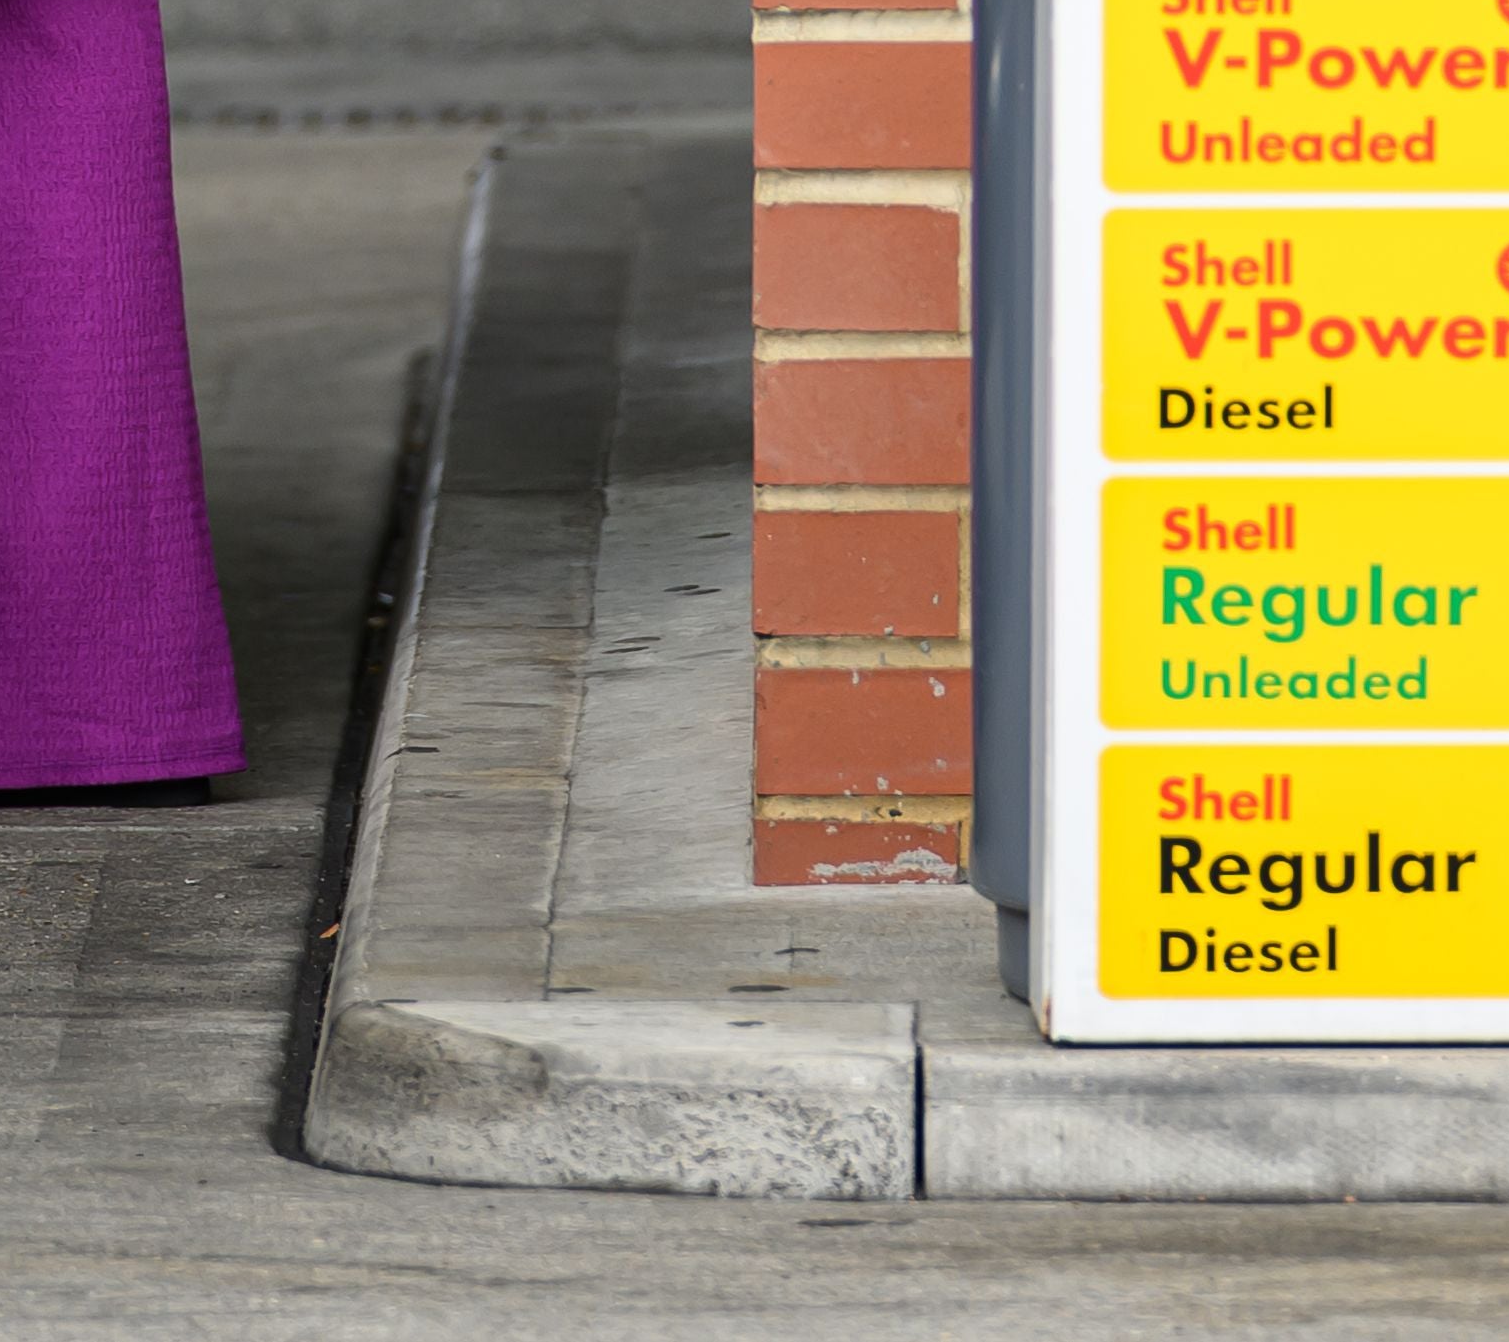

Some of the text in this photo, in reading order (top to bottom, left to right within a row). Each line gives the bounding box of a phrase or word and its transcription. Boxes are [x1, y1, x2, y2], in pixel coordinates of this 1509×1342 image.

[1160, 117, 1436, 164] Unleaded
[1161, 240, 1293, 287] Shell
[1158, 384, 1335, 431] Diesel
[1161, 504, 1296, 553] Shell
[1160, 562, 1480, 645] Regular
[1160, 653, 1429, 702] Unleaded
[1158, 774, 1293, 823] Shell
[1159, 831, 1478, 913] Regular
[1159, 925, 1339, 974] Diesel
